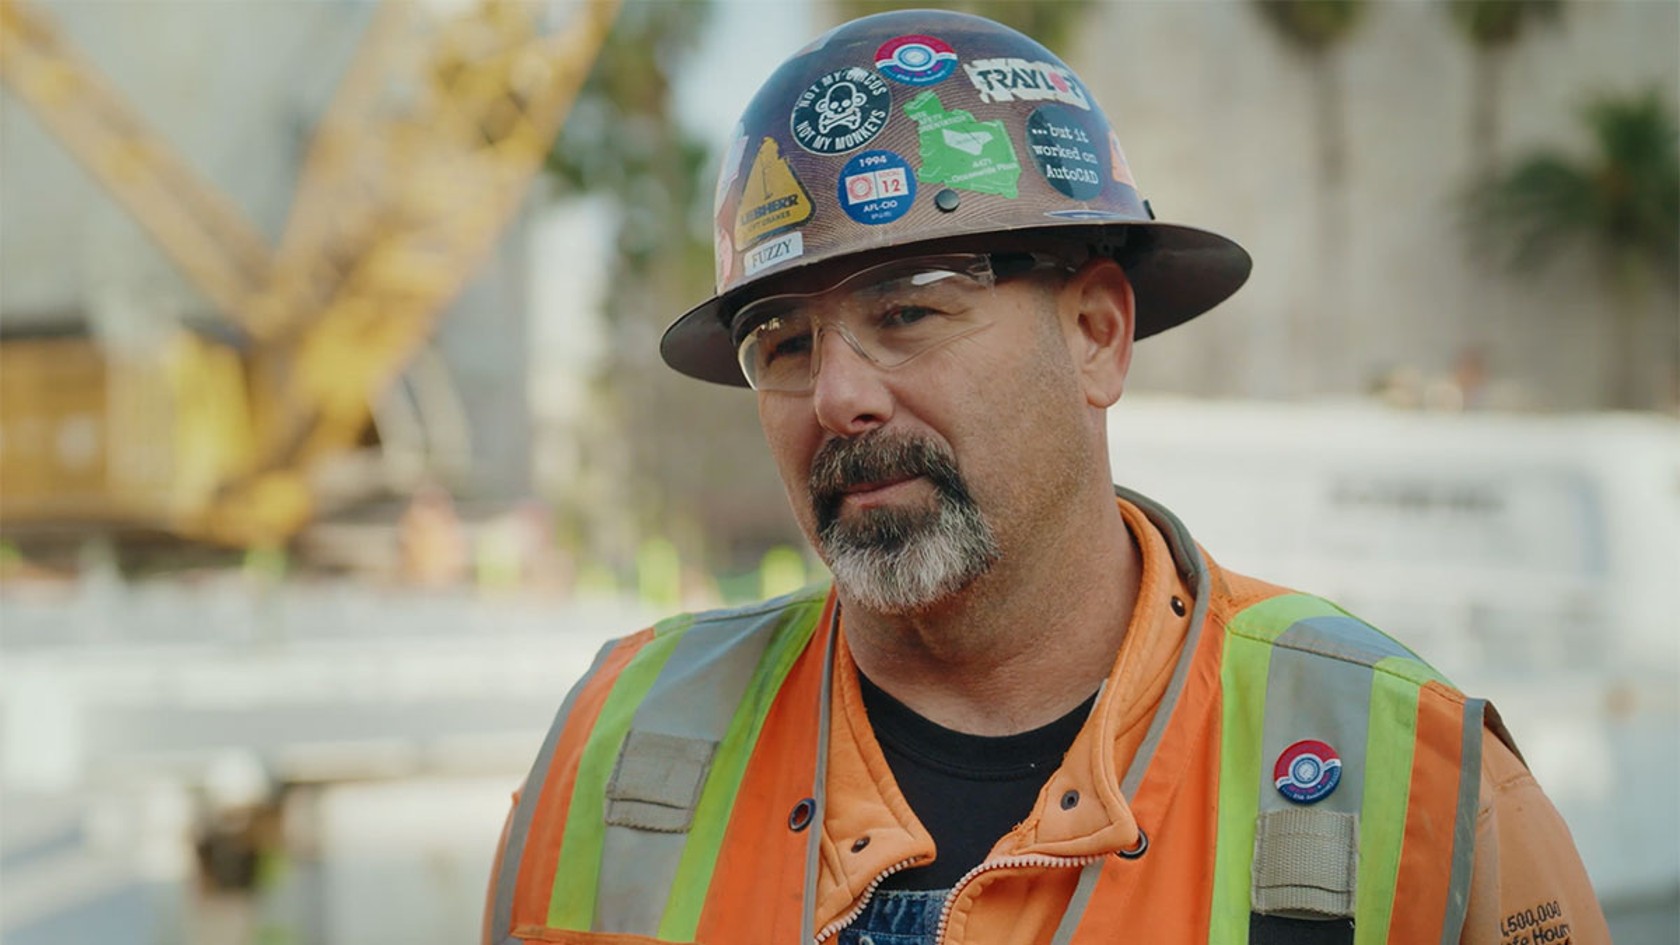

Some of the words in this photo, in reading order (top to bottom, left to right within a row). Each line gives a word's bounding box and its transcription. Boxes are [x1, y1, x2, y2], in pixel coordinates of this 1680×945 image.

[799, 84, 820, 107] NOT
[822, 71, 841, 87] MY
[796, 120, 816, 142] NOT
[811, 135, 833, 150] MY
[835, 109, 886, 150] MONKEYS
[1074, 129, 1089, 143] it
[859, 155, 887, 167] 1994
[1032, 144, 1081, 160] worked
[1082, 152, 1098, 164] on
[1046, 164, 1099, 184] AutoCAD
[882, 179, 901, 193] 12
[863, 200, 898, 213] AFL-CIO
[752, 239, 793, 268] FUZZY
